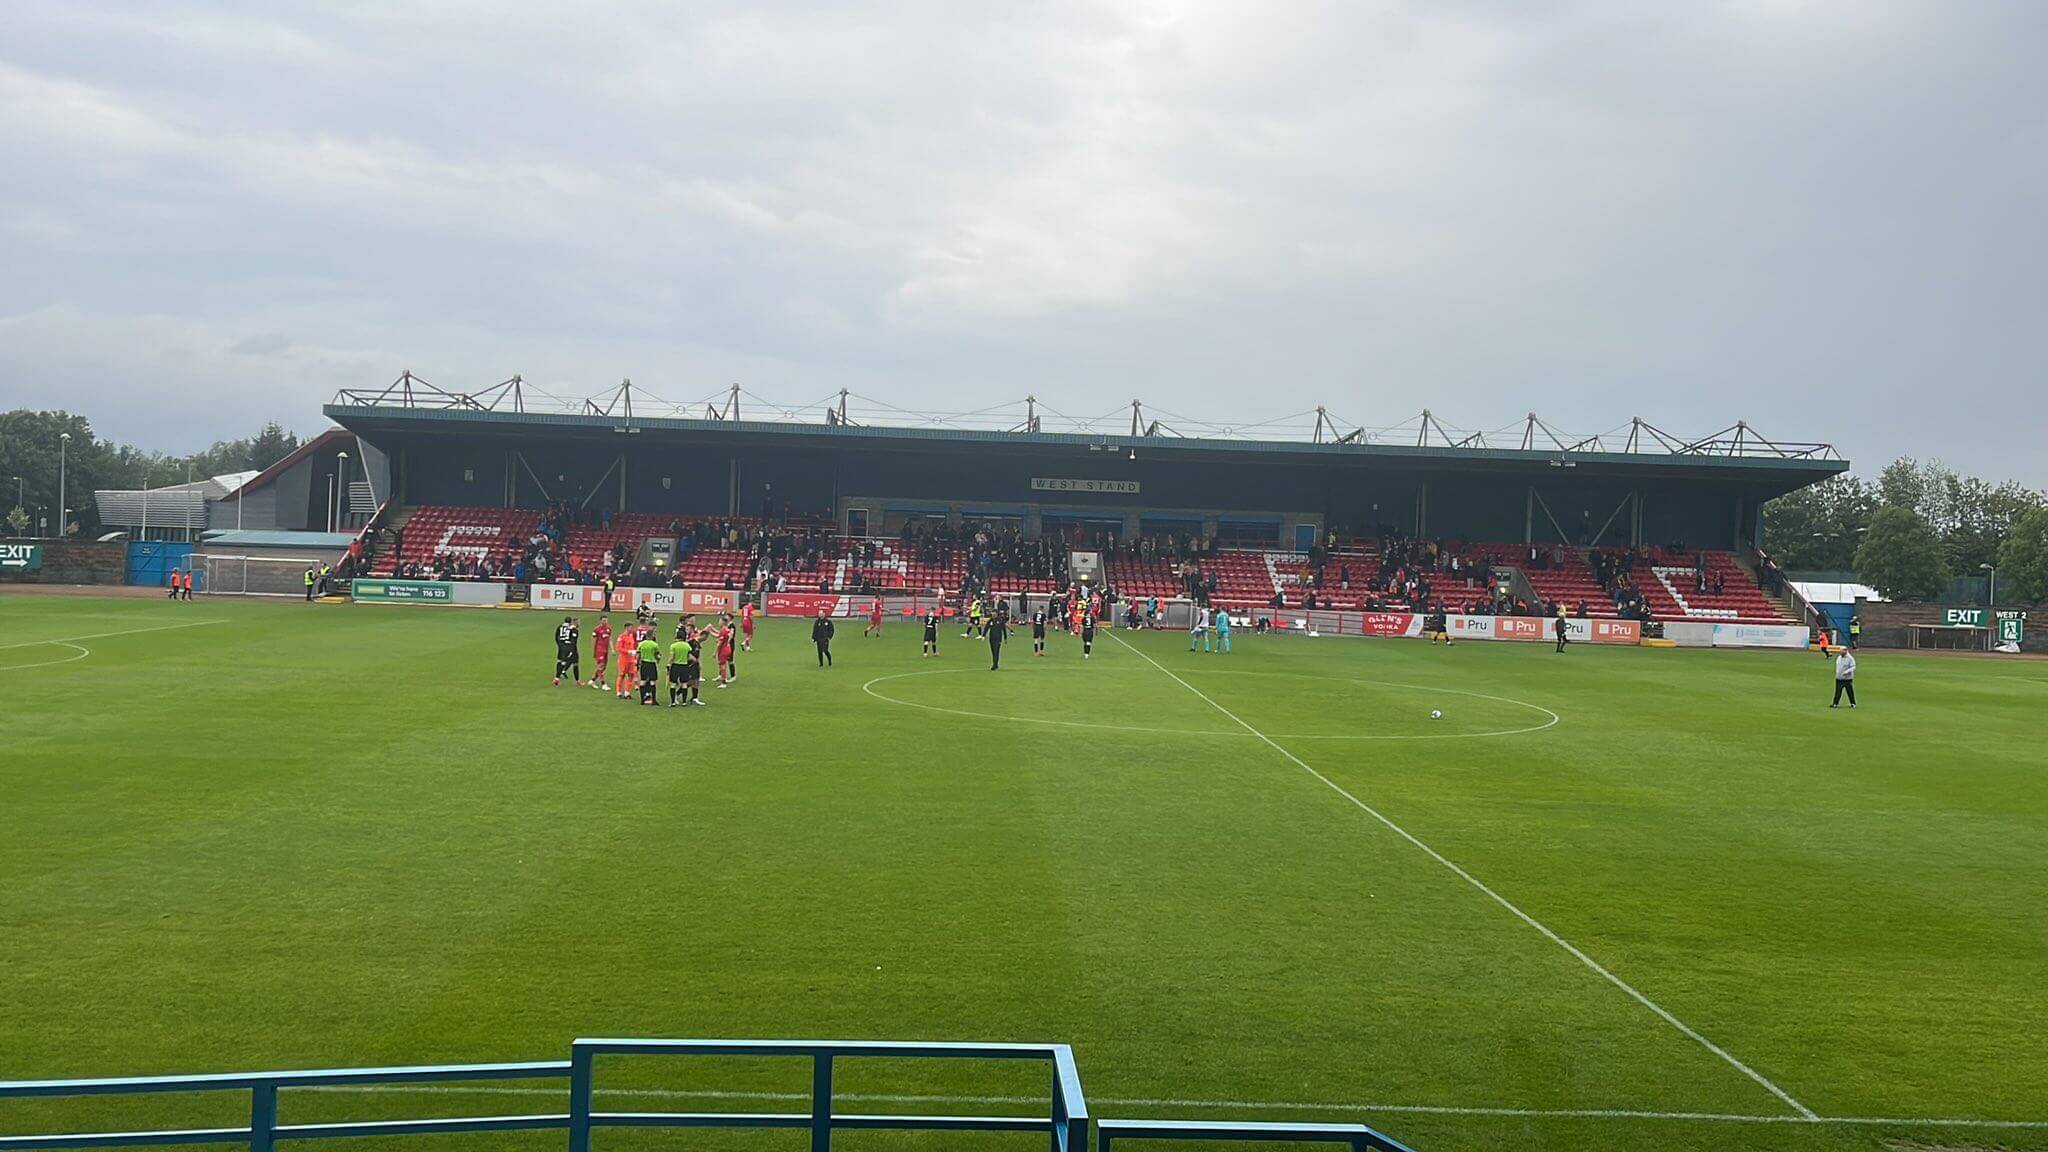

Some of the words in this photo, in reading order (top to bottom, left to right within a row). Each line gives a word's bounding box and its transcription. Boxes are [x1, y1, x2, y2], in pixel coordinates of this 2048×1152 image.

[1036, 479, 1077, 489] WEST
[1087, 481, 1136, 491] STAND
[0, 545, 35, 558] EXIT
[554, 589, 574, 600] Pru
[655, 593, 674, 603] Pru
[704, 594, 725, 605] Pru
[1368, 614, 1403, 625] GLEN'S
[1947, 609, 1981, 623] EXIT
[1996, 611, 2018, 619] WEST
[2021, 611, 2027, 619] 2
[1468, 620, 1487, 630] Pru
[1516, 621, 1536, 632] Pru
[1564, 622, 1584, 633] Pru
[1612, 624, 1632, 635] Pru
